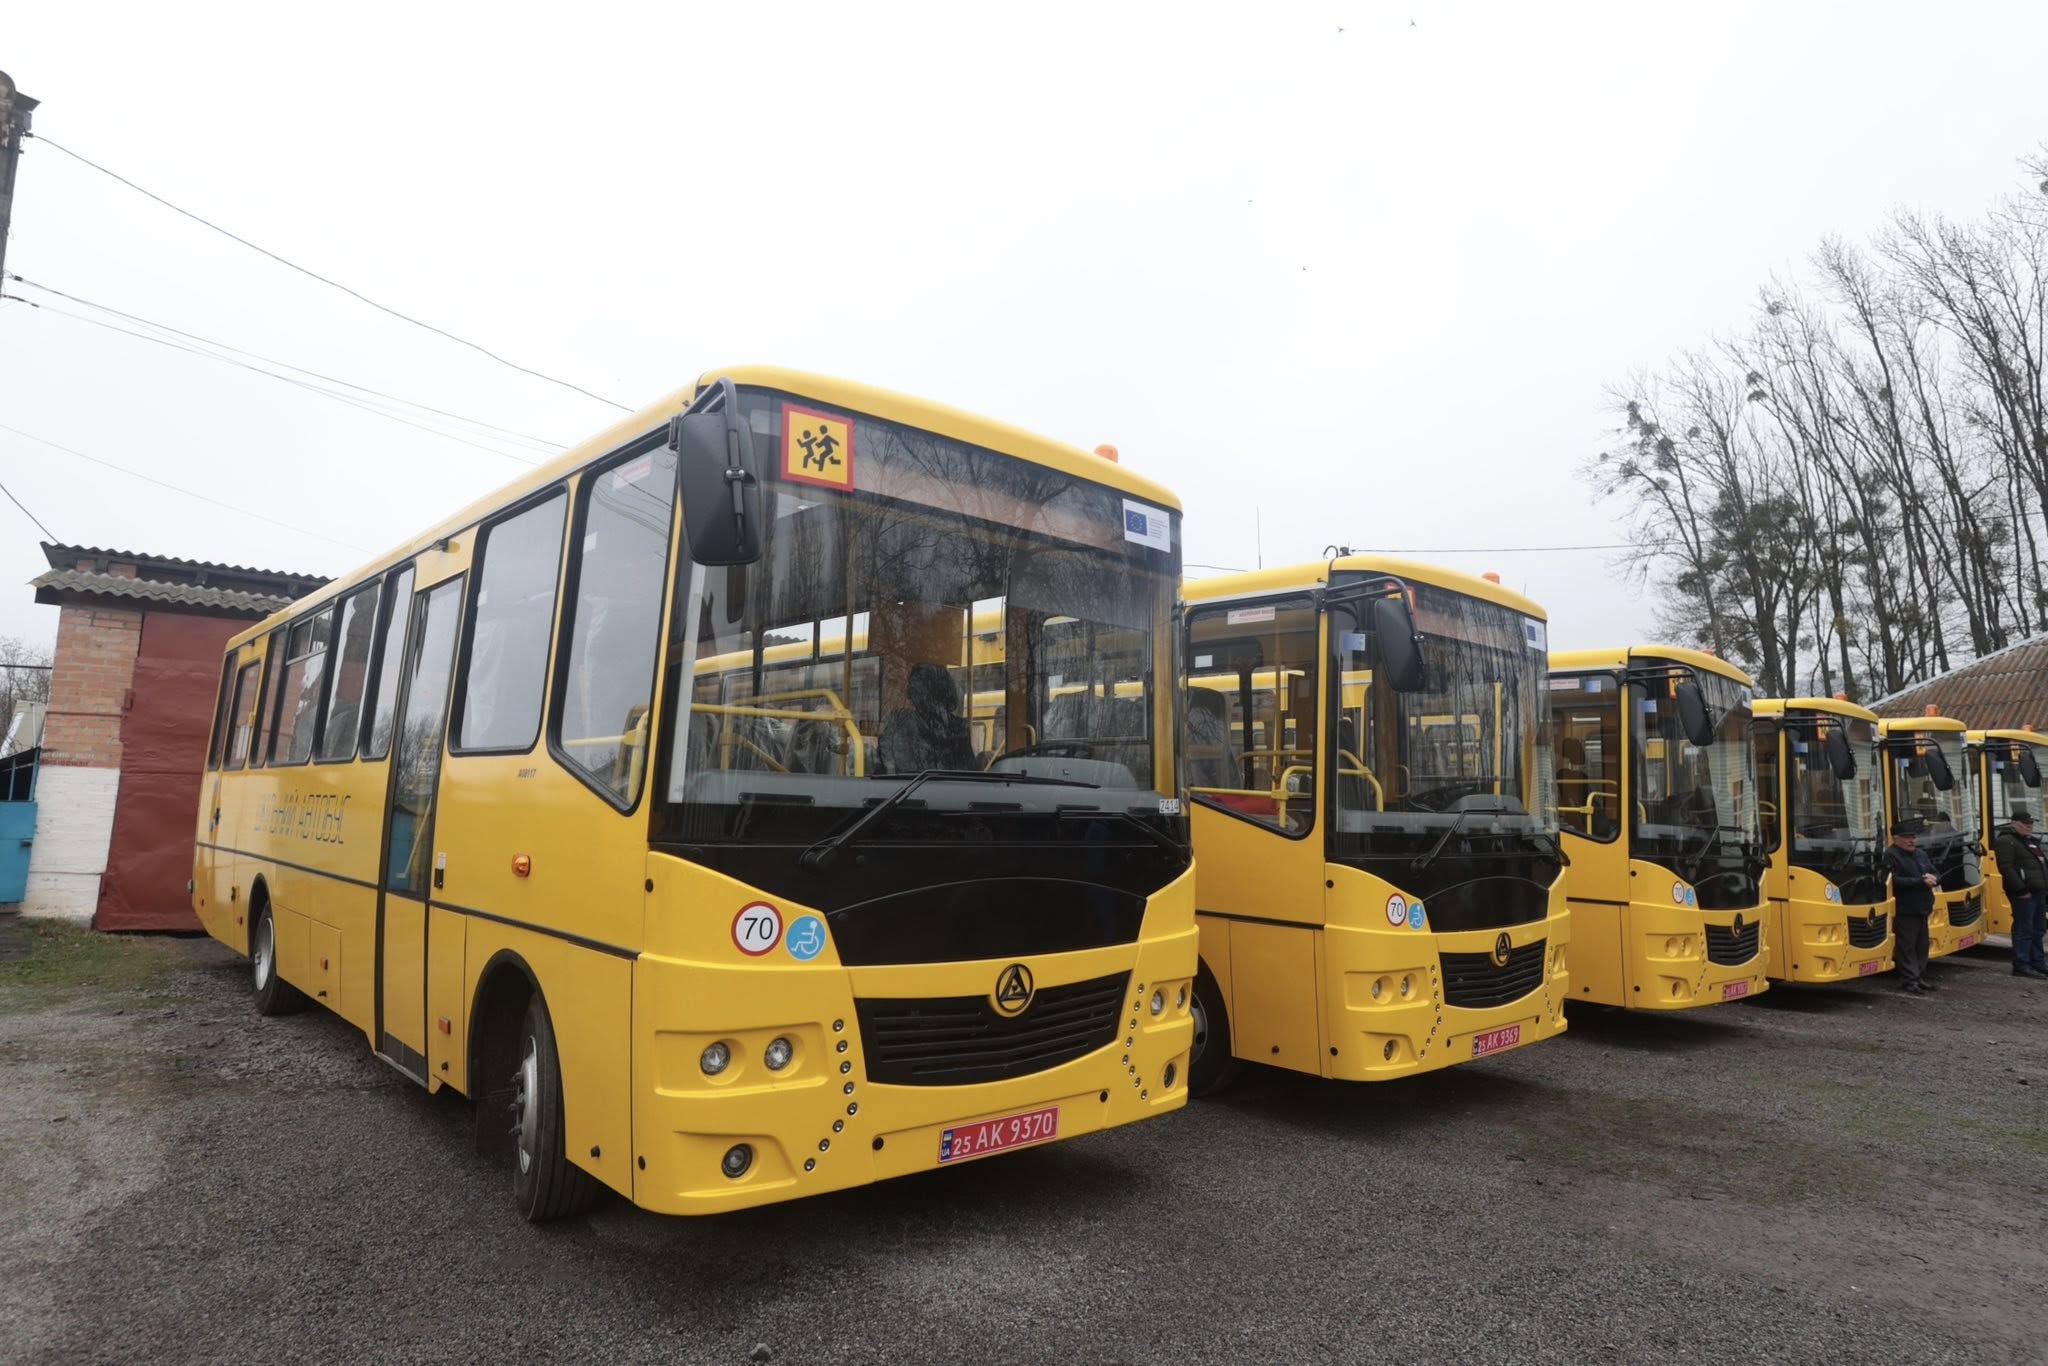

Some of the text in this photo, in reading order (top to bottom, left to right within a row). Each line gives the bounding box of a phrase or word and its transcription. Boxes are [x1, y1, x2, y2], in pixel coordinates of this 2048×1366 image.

[299, 793, 351, 844] АВТОБУС
[1390, 902, 1403, 917] 70
[744, 917, 774, 940] 70
[1487, 1032, 1499, 1049] AK
[941, 1112, 1053, 1157] UA 25 AK 9370
